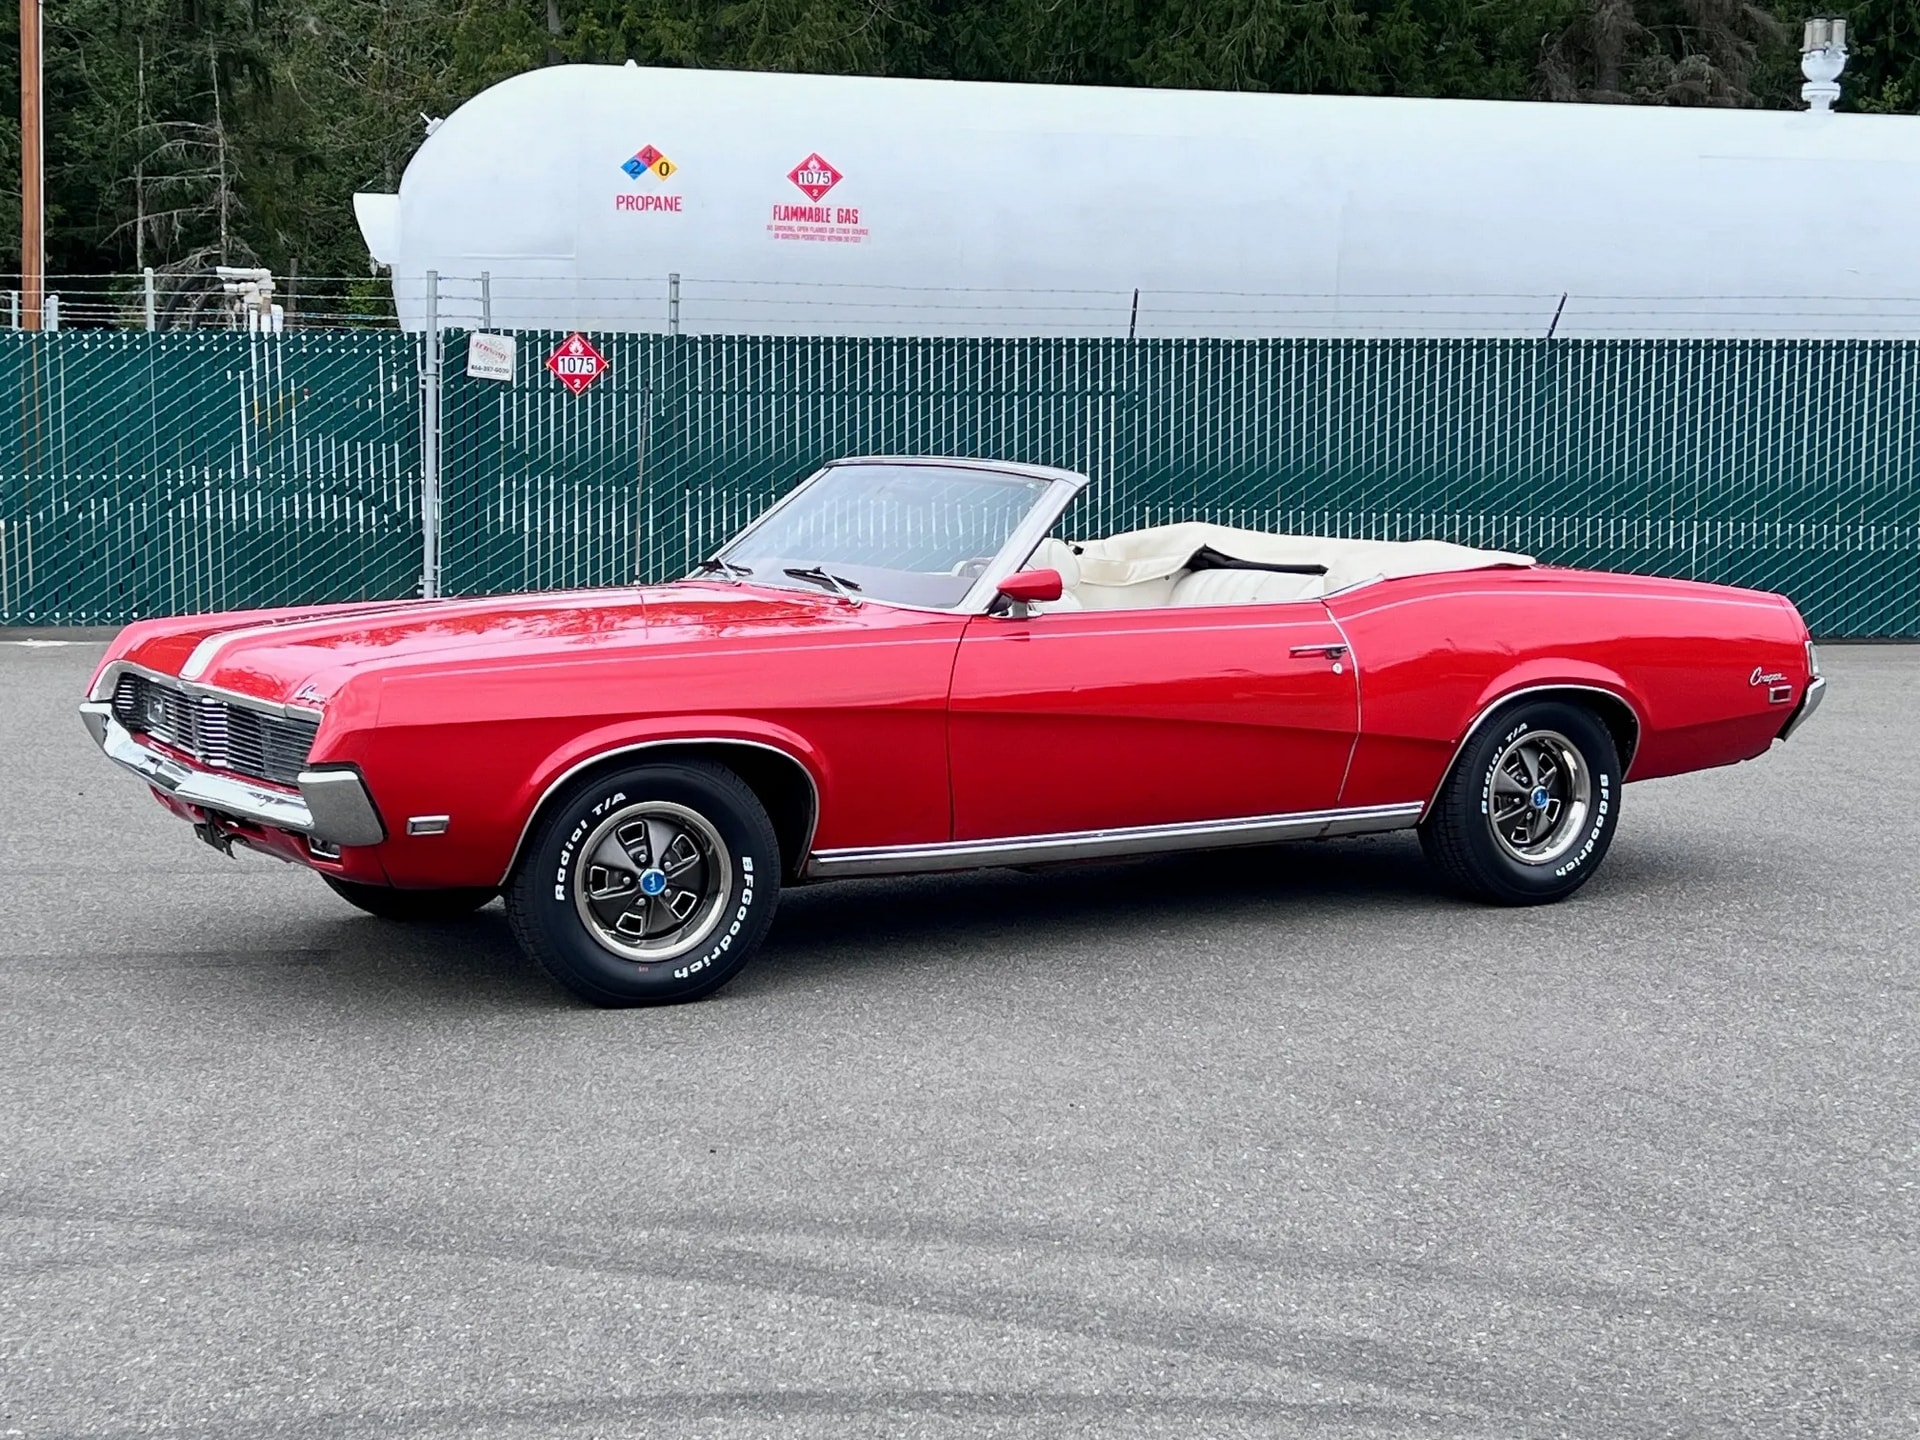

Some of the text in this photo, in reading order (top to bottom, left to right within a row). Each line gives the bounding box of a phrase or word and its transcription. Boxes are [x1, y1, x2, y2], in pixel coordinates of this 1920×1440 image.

[644, 149, 654, 162] 4
[628, 159, 669, 176] 2 0
[800, 171, 830, 184] 1075
[812, 189, 819, 197] 2
[616, 195, 682, 211] PROPANE
[773, 205, 858, 224] FLAMMABLE GAS
[560, 357, 594, 373] 1075
[573, 379, 581, 388] 2
[1481, 722, 1529, 815] Radial T/A
[1555, 773, 1609, 877] BFGoodrich
[554, 791, 627, 901] Radial T/A
[673, 856, 755, 979] BFGoodrich
